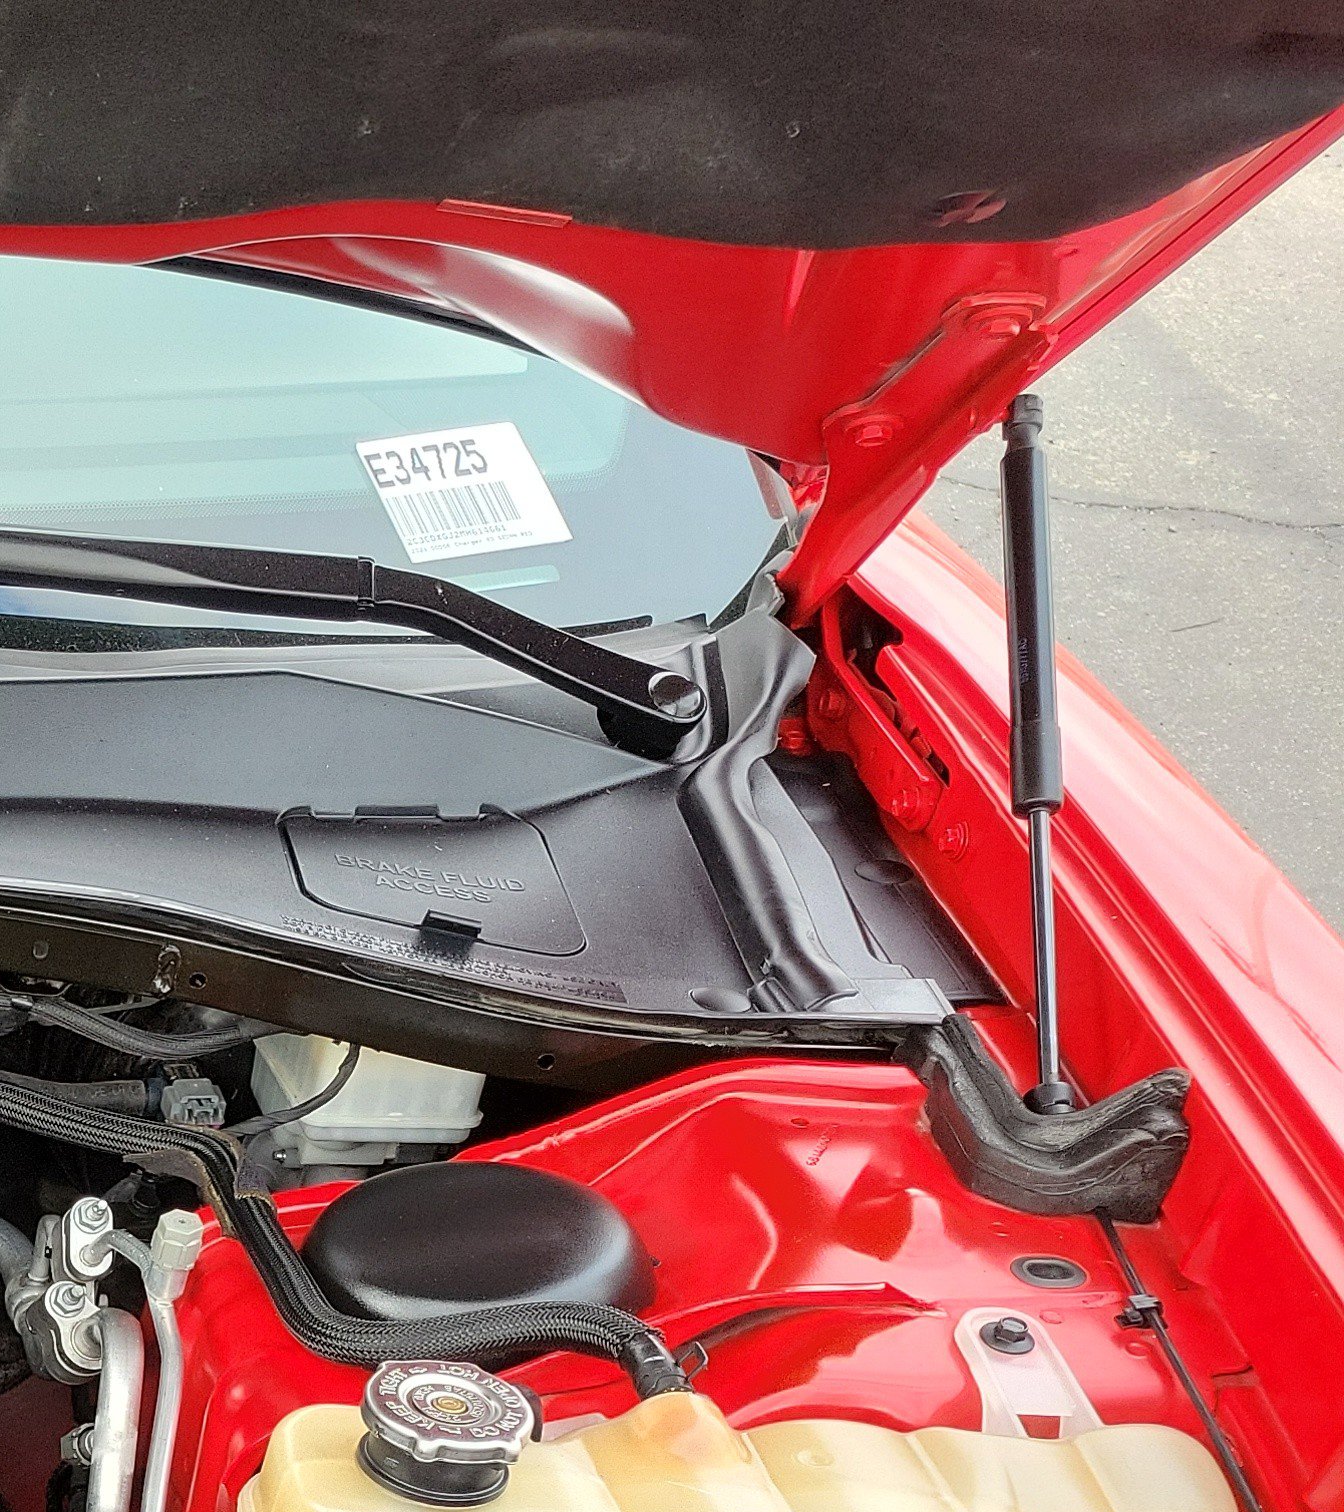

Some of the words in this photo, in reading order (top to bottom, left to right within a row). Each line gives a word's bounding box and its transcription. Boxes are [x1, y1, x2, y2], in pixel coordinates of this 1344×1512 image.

[363, 438, 488, 489] E34725
[334, 853, 434, 881] BRAKE
[441, 870, 525, 893] FLUID
[375, 875, 493, 904] ACCESS
[378, 1367, 409, 1396] TIGHT
[385, 1400, 435, 1431] KEEP
